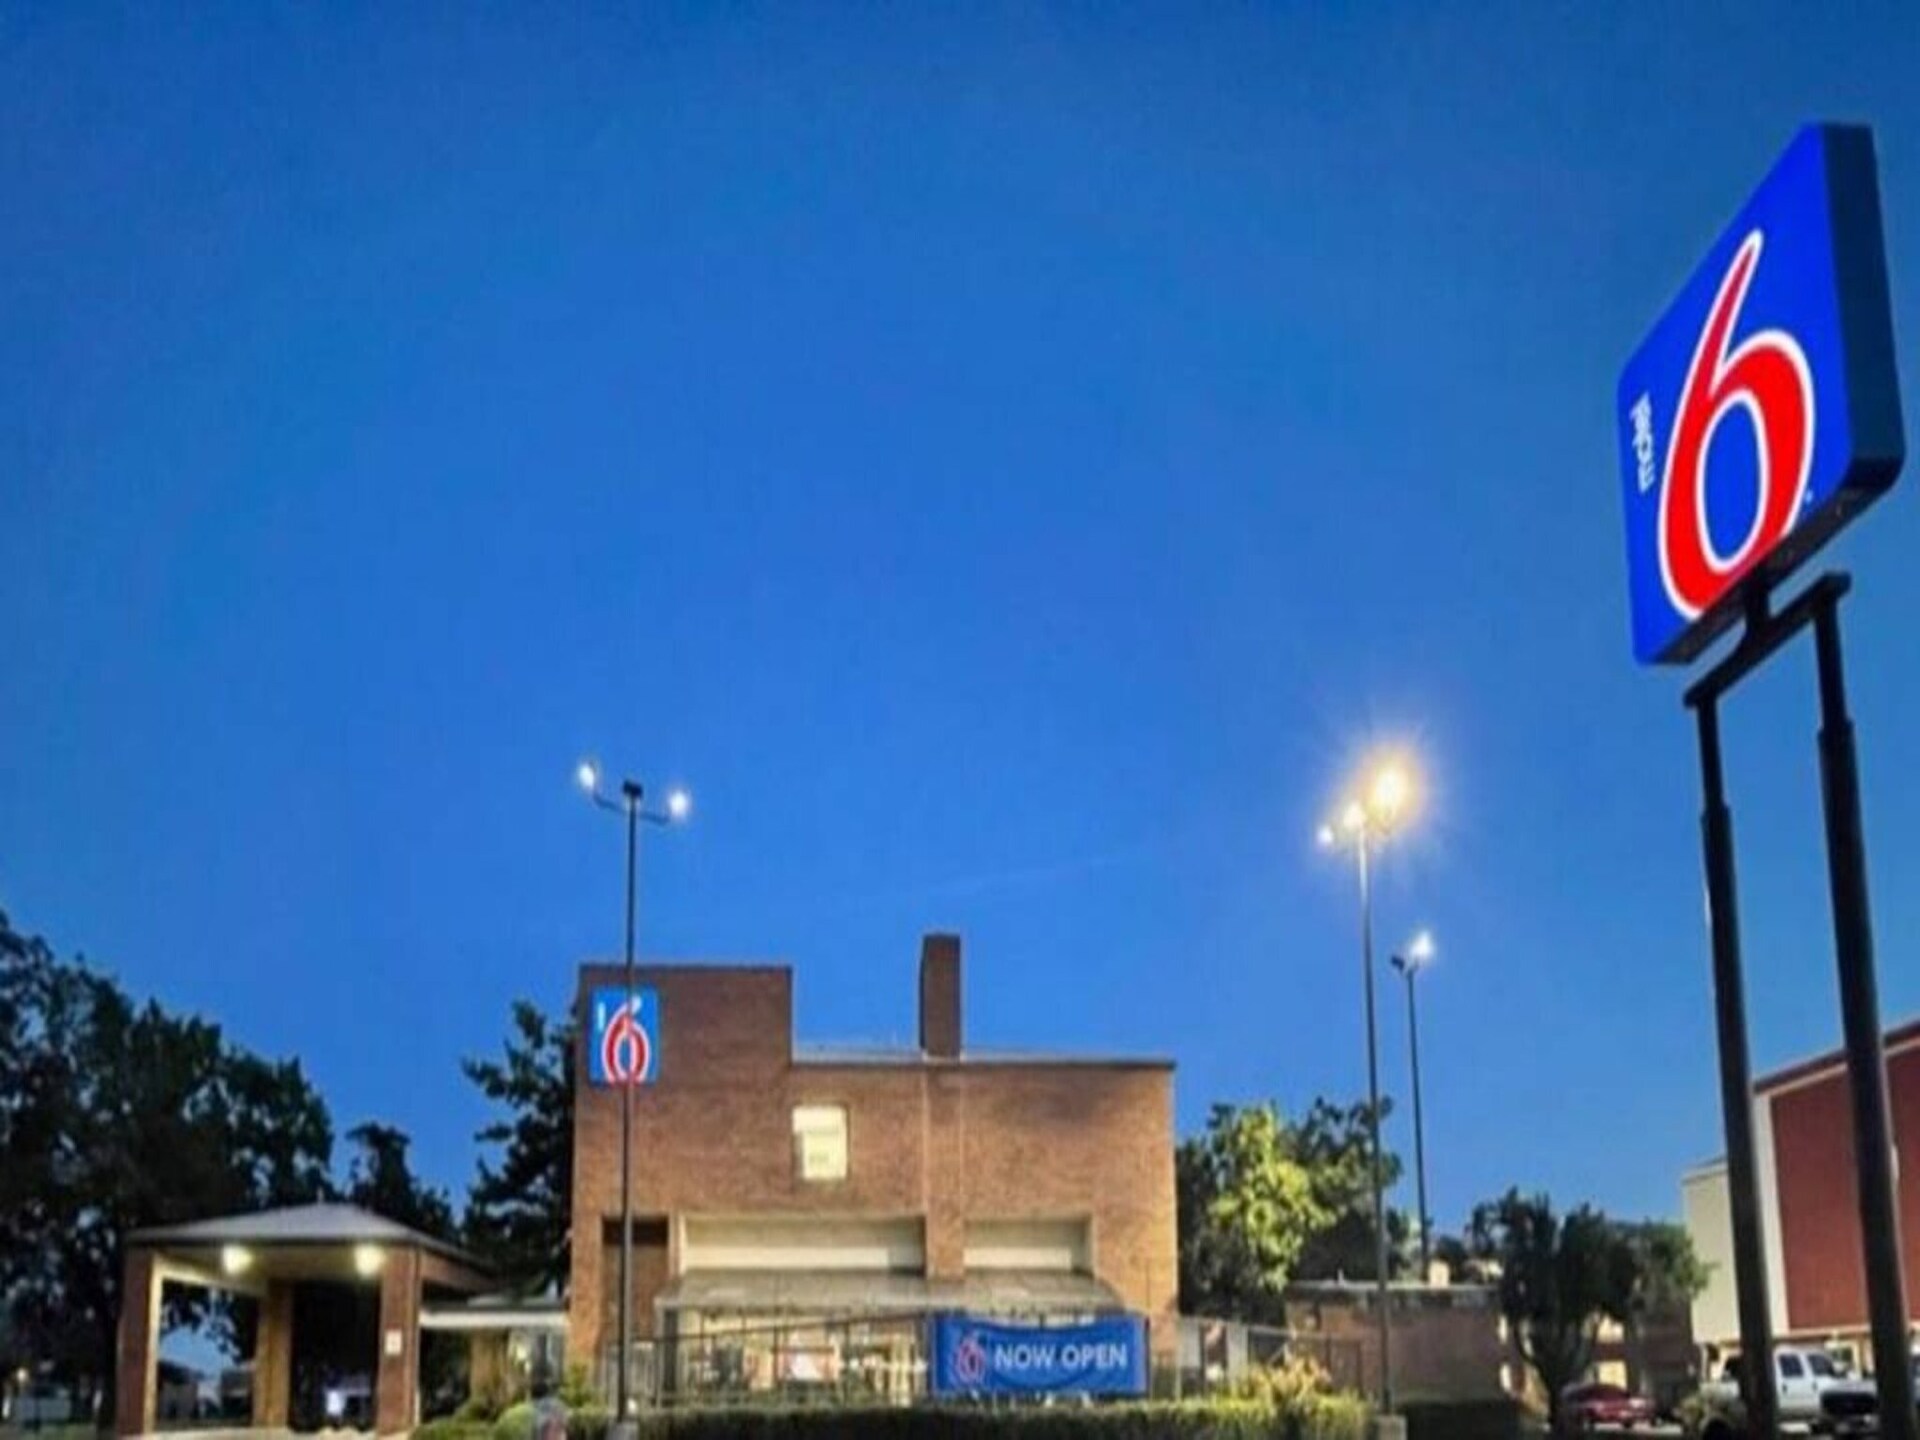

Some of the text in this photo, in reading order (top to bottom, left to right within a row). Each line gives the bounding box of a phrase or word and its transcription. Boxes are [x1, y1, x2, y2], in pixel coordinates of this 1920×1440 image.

[1657, 228, 1815, 620] 6
[601, 994, 652, 1085] 6
[994, 1343, 1128, 1370] NOW OPEN
